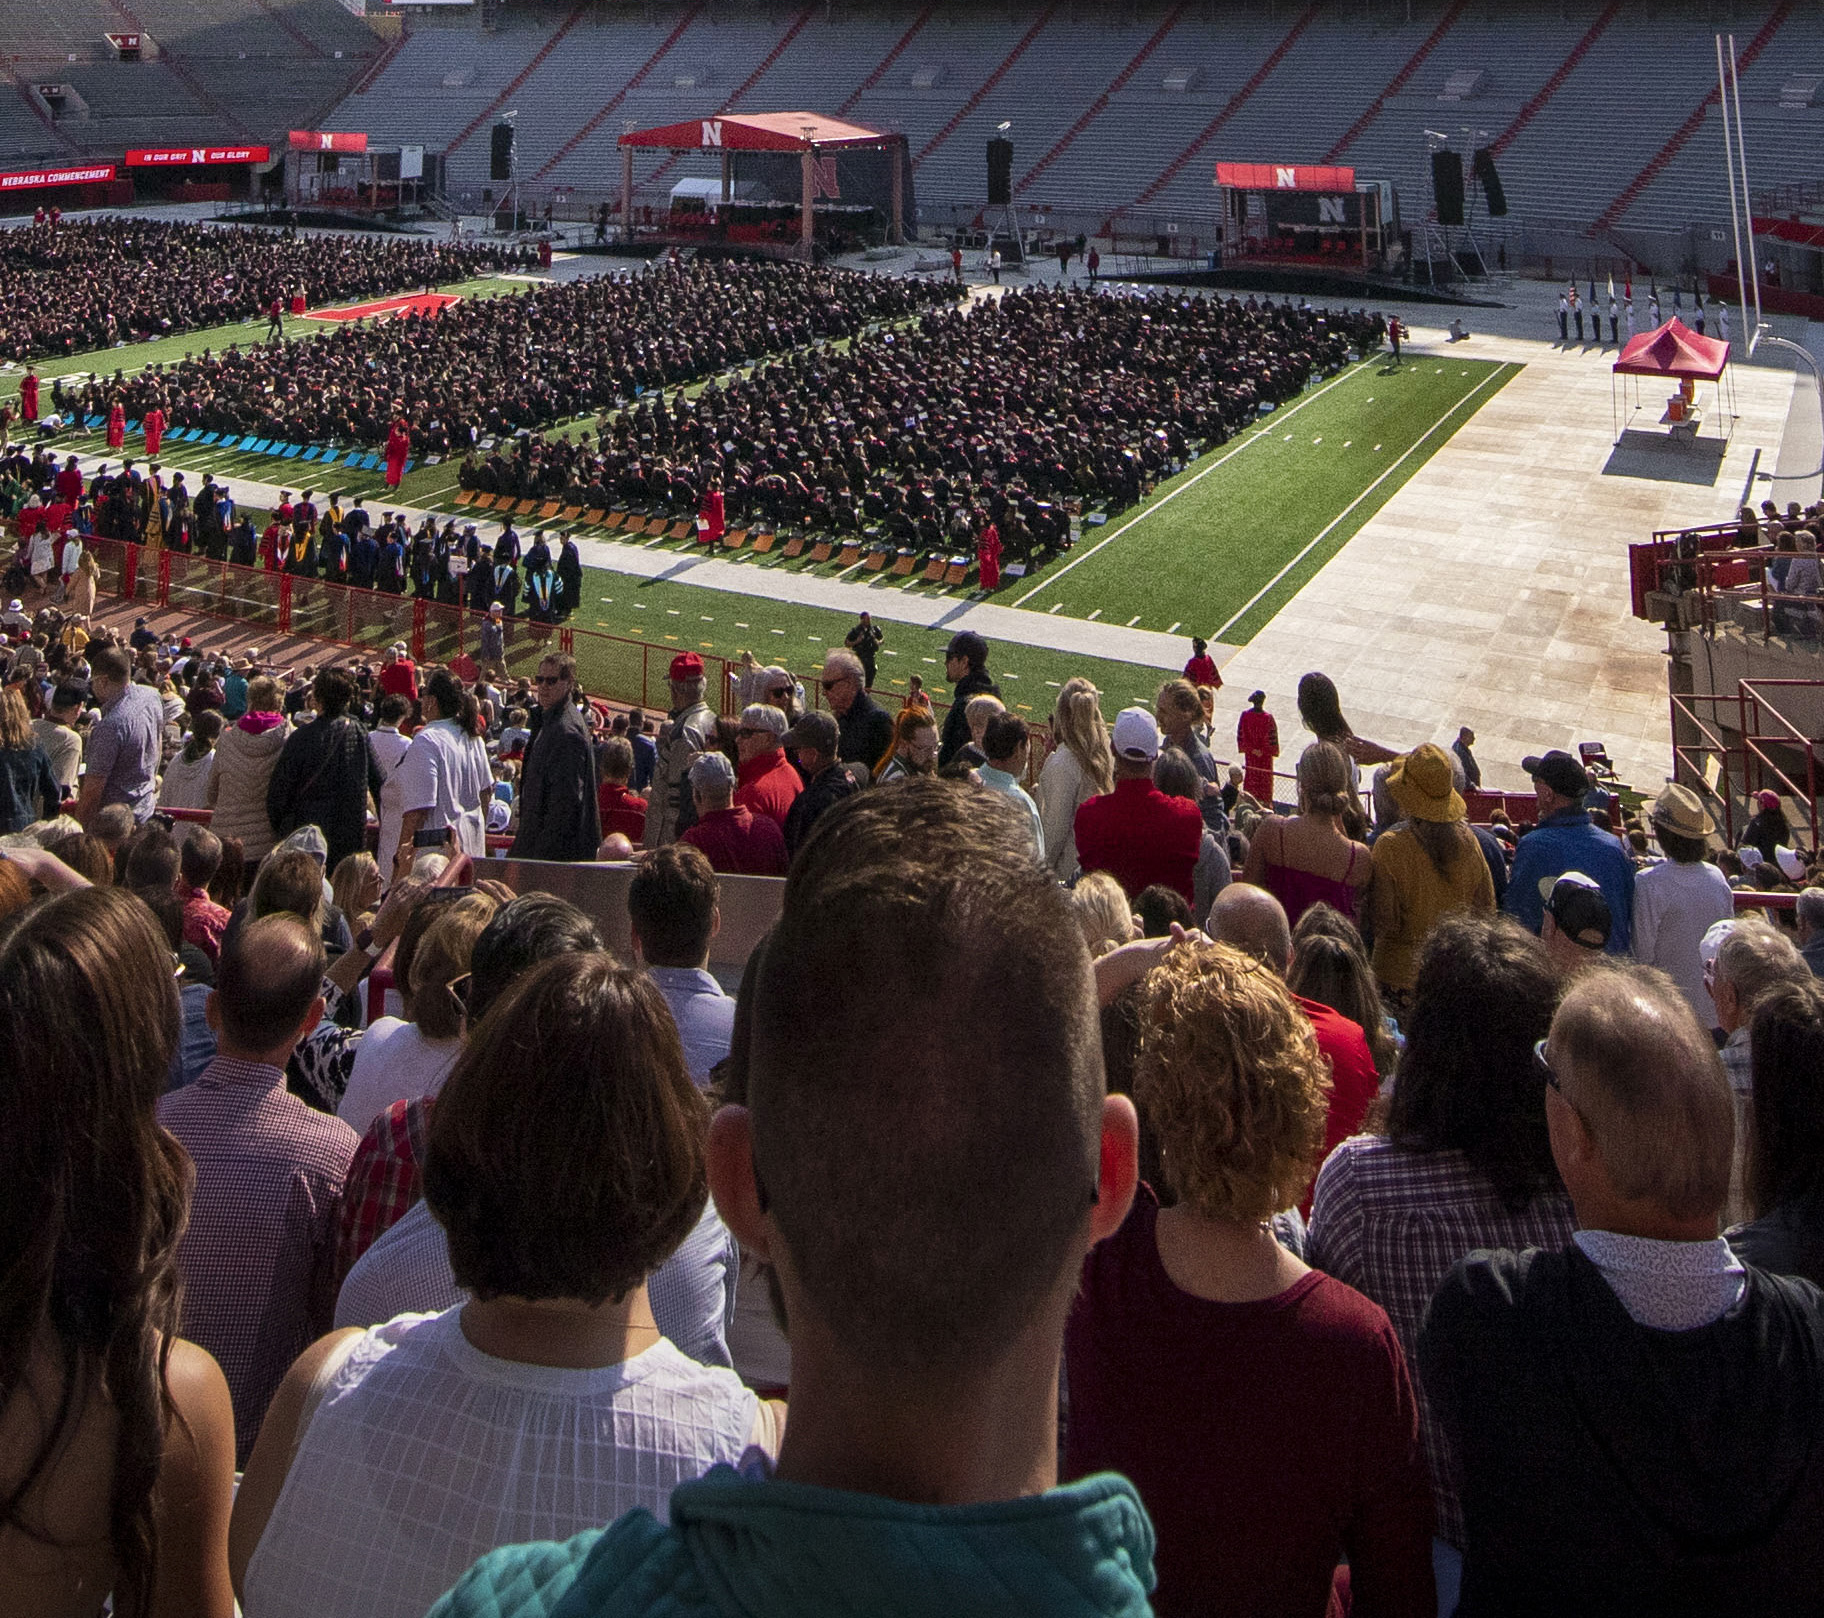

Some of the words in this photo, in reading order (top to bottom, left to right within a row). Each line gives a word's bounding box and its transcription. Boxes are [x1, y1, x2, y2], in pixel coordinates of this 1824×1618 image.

[321, 134, 333, 149] N
[702, 121, 722, 146] N
[192, 150, 205, 162] N
[2, 174, 45, 186] NEBRASKA
[47, 169, 110, 182] COMMENCEMENT
[806, 156, 841, 198] N
[1276, 168, 1296, 188] N
[1318, 196, 1346, 222] N
